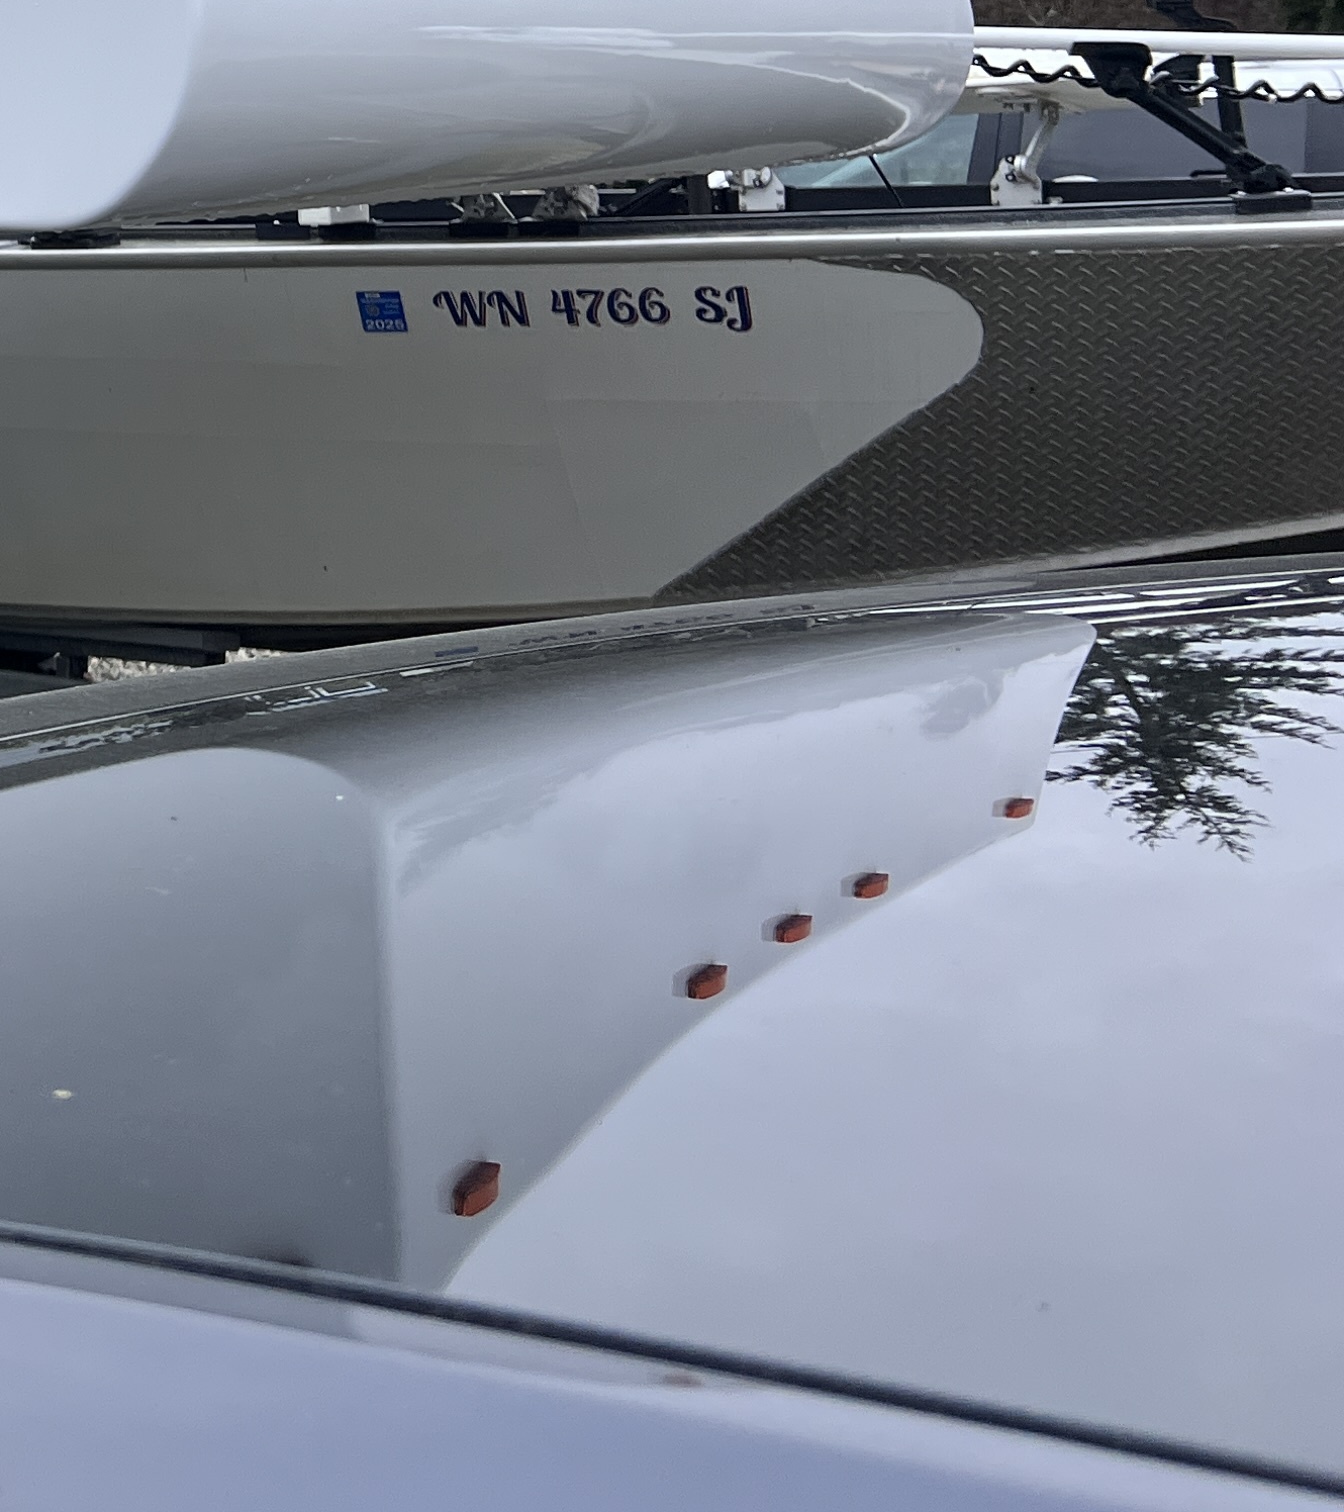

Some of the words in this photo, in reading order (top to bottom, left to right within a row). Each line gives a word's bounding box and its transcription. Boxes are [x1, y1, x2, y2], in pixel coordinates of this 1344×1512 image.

[433, 289, 531, 328] WN
[551, 287, 672, 326] 4766
[694, 286, 754, 333] SJ
